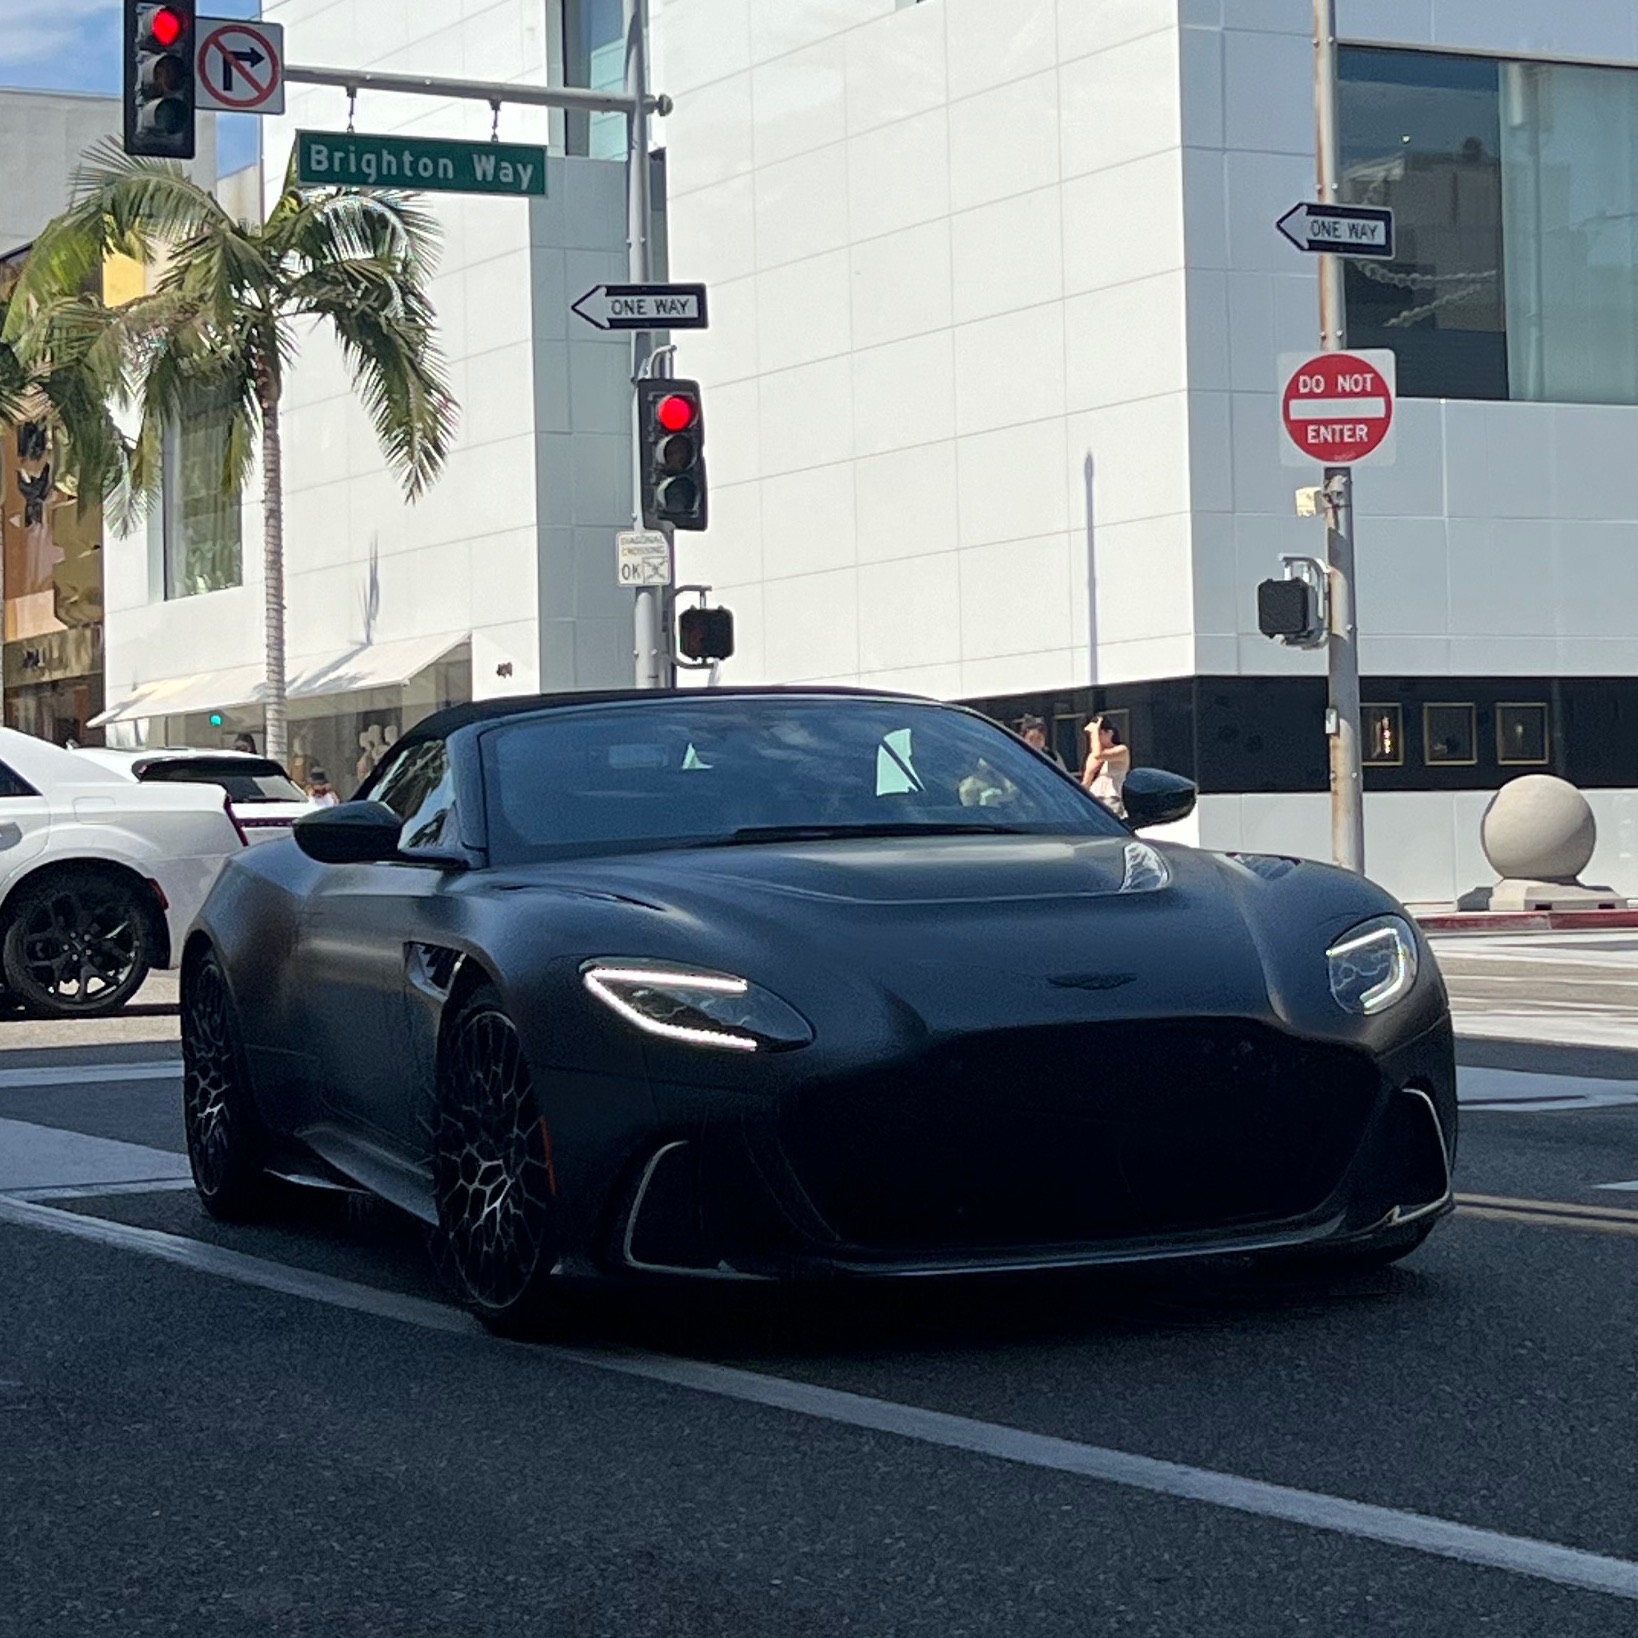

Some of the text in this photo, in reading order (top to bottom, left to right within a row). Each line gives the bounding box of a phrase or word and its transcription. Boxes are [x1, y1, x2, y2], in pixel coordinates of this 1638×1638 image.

[310, 144, 534, 191] Brighton Way
[1310, 219, 1378, 241] ONE WAY
[611, 298, 690, 316] ONE WAY
[1298, 373, 1375, 394] DO NOT
[1306, 423, 1368, 444] ENTER
[621, 563, 641, 581] OK
